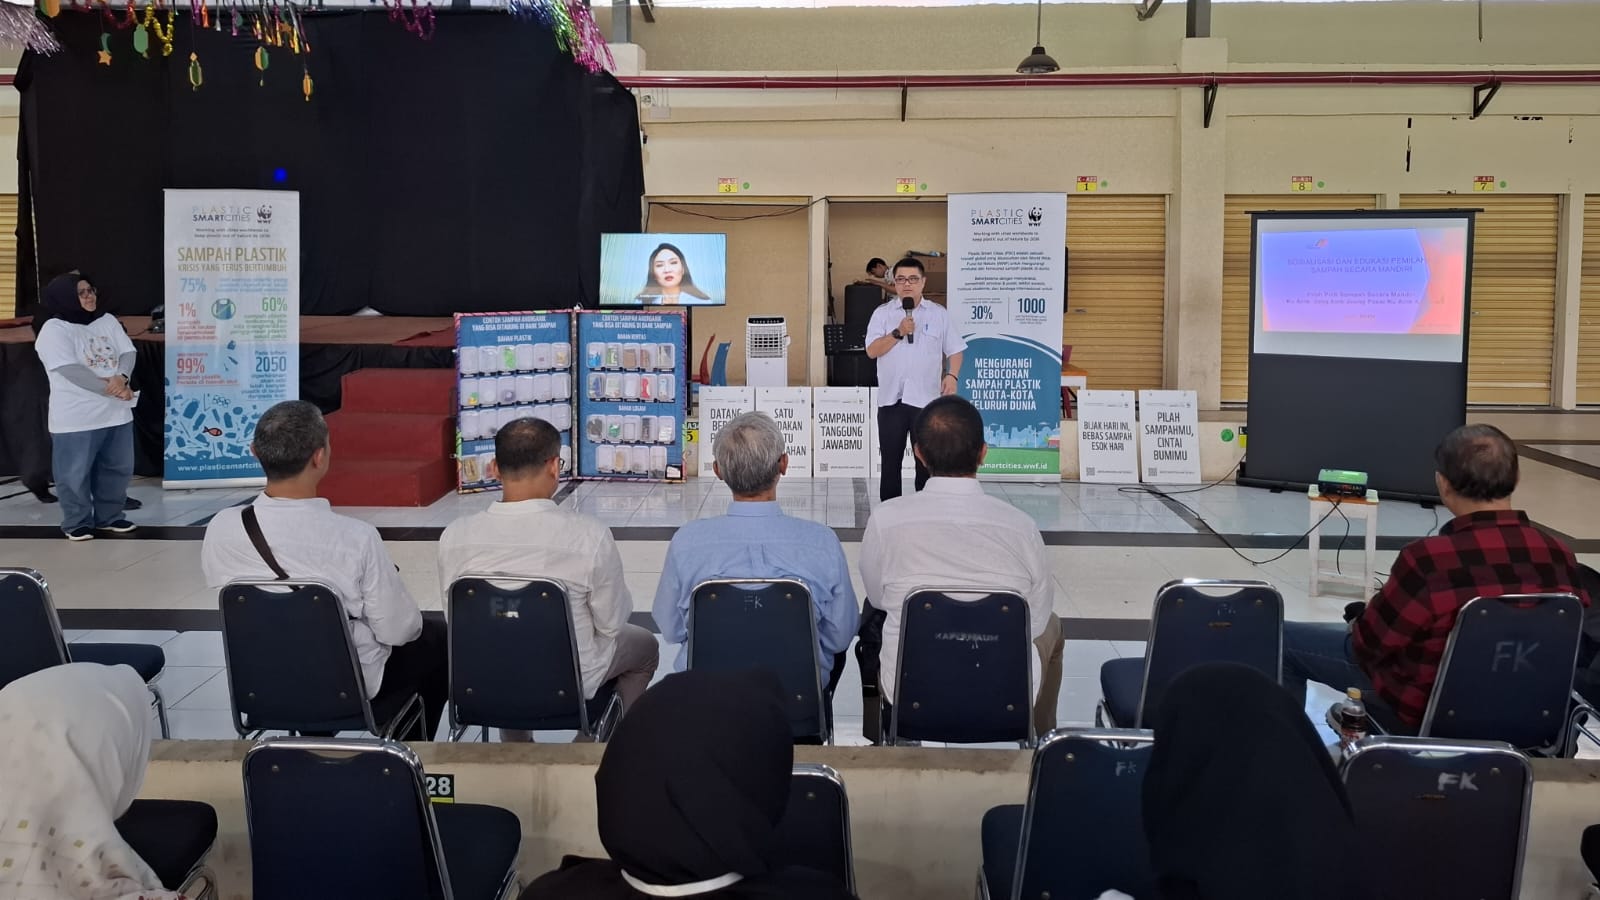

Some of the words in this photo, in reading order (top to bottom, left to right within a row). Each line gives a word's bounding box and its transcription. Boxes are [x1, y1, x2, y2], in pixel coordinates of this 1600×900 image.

[192, 206, 252, 214] PLASTIC
[970, 208, 1024, 218] PLASTIC
[971, 218, 1022, 226] SMARTCITIES
[178, 248, 231, 262] SAMPAH
[236, 248, 286, 262] PLASTIK
[178, 264, 200, 272] KRISIS
[202, 264, 220, 272] YANG
[222, 264, 243, 272] TERUS
[244, 264, 286, 272] BERTUMBUH
[180, 278, 206, 292] 75%
[262, 297, 288, 312] 60%
[1018, 298, 1046, 314] 1000
[179, 304, 196, 318] 1%
[971, 305, 993, 320] 30%
[177, 358, 205, 374] 99%
[256, 356, 287, 372] 2050
[974, 358, 1032, 368] MENGURANGI
[978, 368, 1029, 379] KEBOCORAN
[966, 379, 1003, 390] SAMPAH
[1004, 379, 1041, 390] PLASTIK
[972, 390, 982, 400] DI
[984, 390, 1034, 400] KOTA-KOTA
[1010, 400, 1036, 410] DUNIA
[774, 408, 794, 419] SATU
[818, 414, 865, 424] SAMPAHMU
[1157, 412, 1180, 422] PILAH
[1084, 421, 1102, 430] BIJAK
[1104, 422, 1119, 430] HARI
[1145, 424, 1194, 438] SAMPAHMU,
[821, 426, 862, 437] TANGGUNG
[1082, 432, 1104, 440] BEBAS
[1104, 432, 1132, 440] SAMPAH
[821, 440, 862, 450] JAWABMU
[1092, 442, 1108, 450] ESOK
[1109, 442, 1124, 451] HARI
[1157, 438, 1182, 448] CINTAI
[1154, 450, 1188, 461] BUMIMU
[1490, 641, 1539, 673] FK
[426, 776, 450, 796] 28
[1438, 772, 1479, 791] FK
